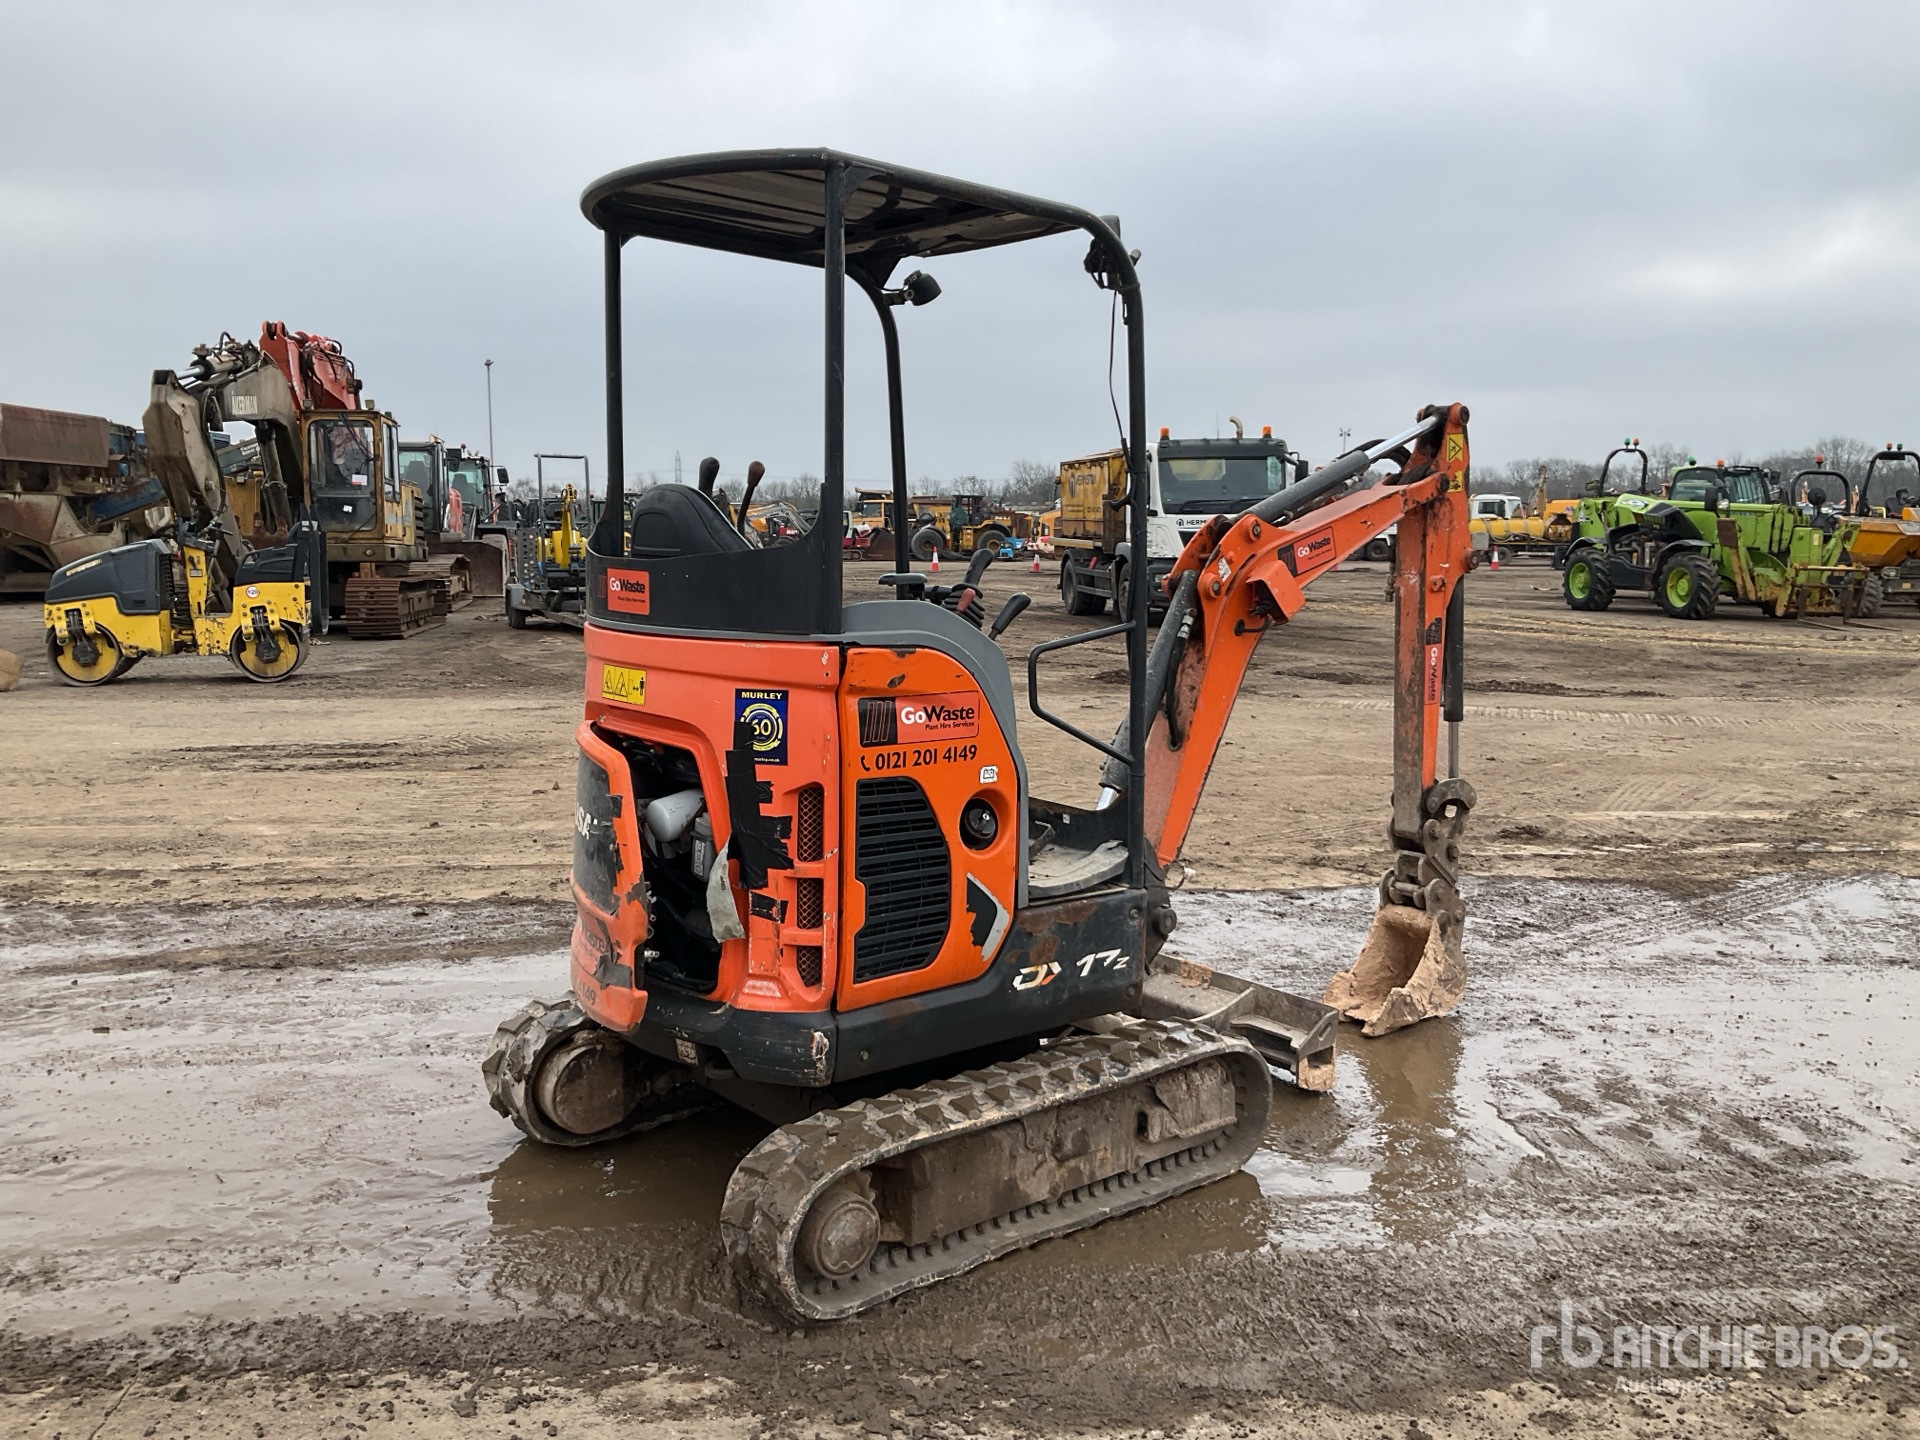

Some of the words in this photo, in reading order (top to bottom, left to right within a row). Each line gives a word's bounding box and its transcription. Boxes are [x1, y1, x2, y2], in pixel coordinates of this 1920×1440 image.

[1297, 537, 1331, 557] GoWaste
[610, 577, 645, 594] GoWaste
[741, 691, 782, 700] MURLEY
[901, 705, 975, 725] GoWaste
[925, 723, 939, 731] Plant
[953, 720, 975, 728] Services
[875, 751, 907, 771] 0121
[912, 748, 938, 767] 201
[942, 744, 978, 764] 4149
